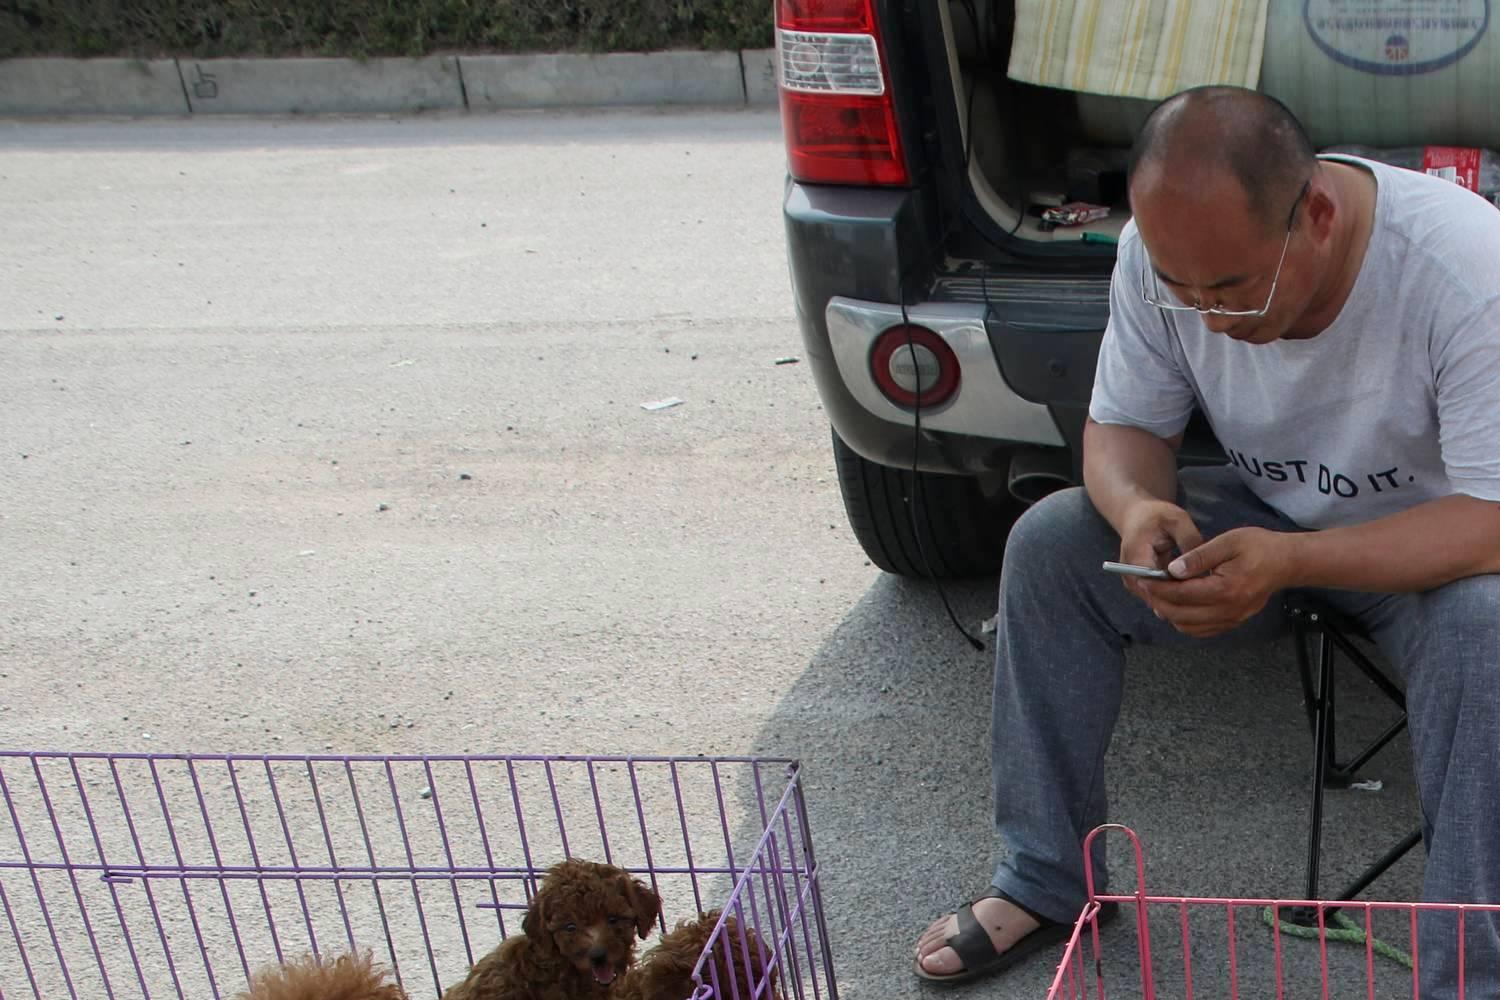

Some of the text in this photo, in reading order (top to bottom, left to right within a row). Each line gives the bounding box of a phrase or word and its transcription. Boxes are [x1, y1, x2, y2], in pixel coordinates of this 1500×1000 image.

[1229, 448, 1415, 498] JUST DO IT.
